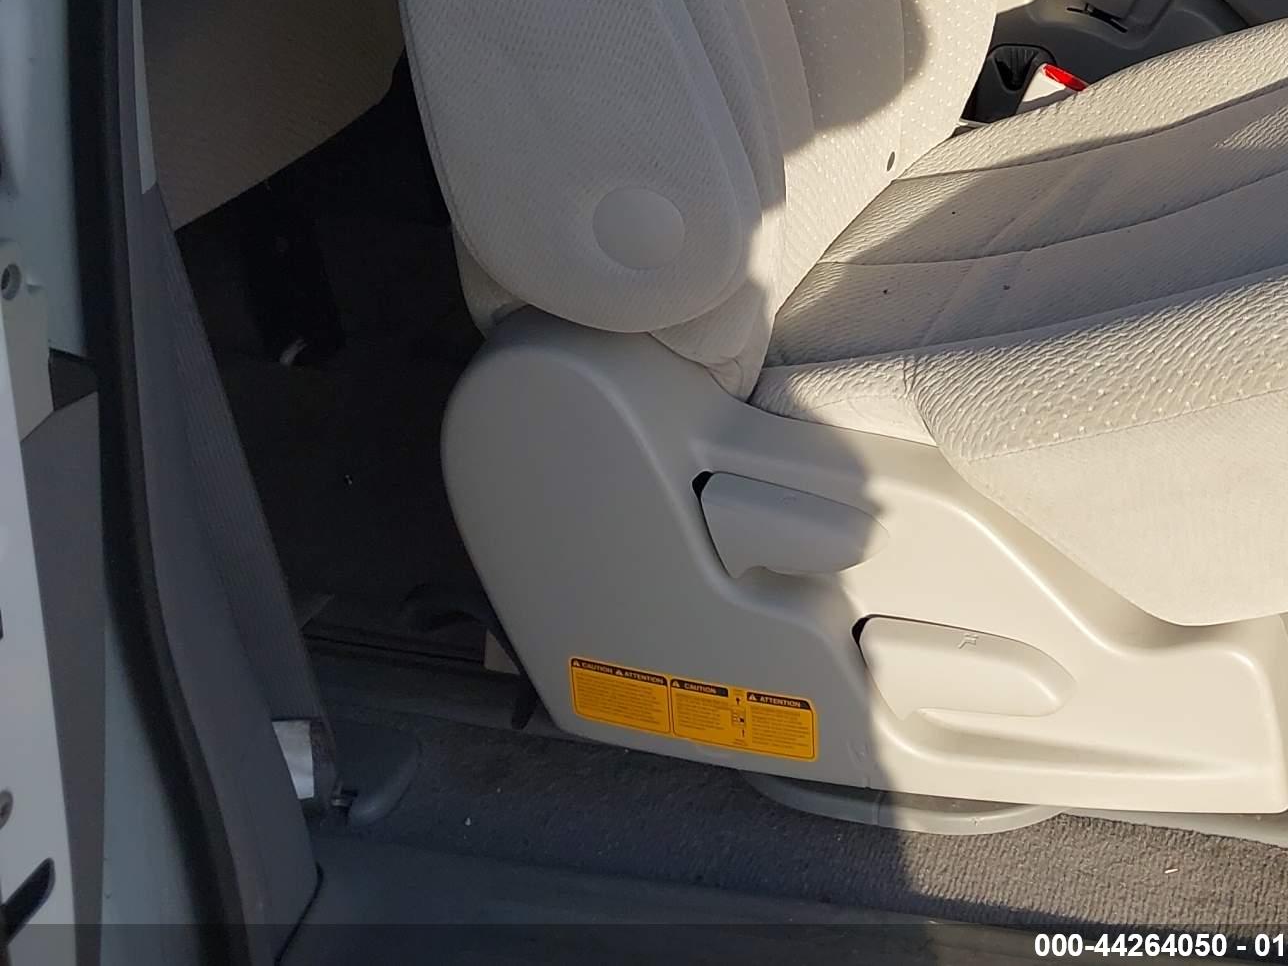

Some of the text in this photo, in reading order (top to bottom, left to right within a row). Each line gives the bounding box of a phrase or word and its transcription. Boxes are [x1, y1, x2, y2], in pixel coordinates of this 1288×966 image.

[581, 662, 664, 685] CAUTION ATTENTION
[684, 682, 717, 694] CAUTION
[759, 696, 801, 708] ATTENTION
